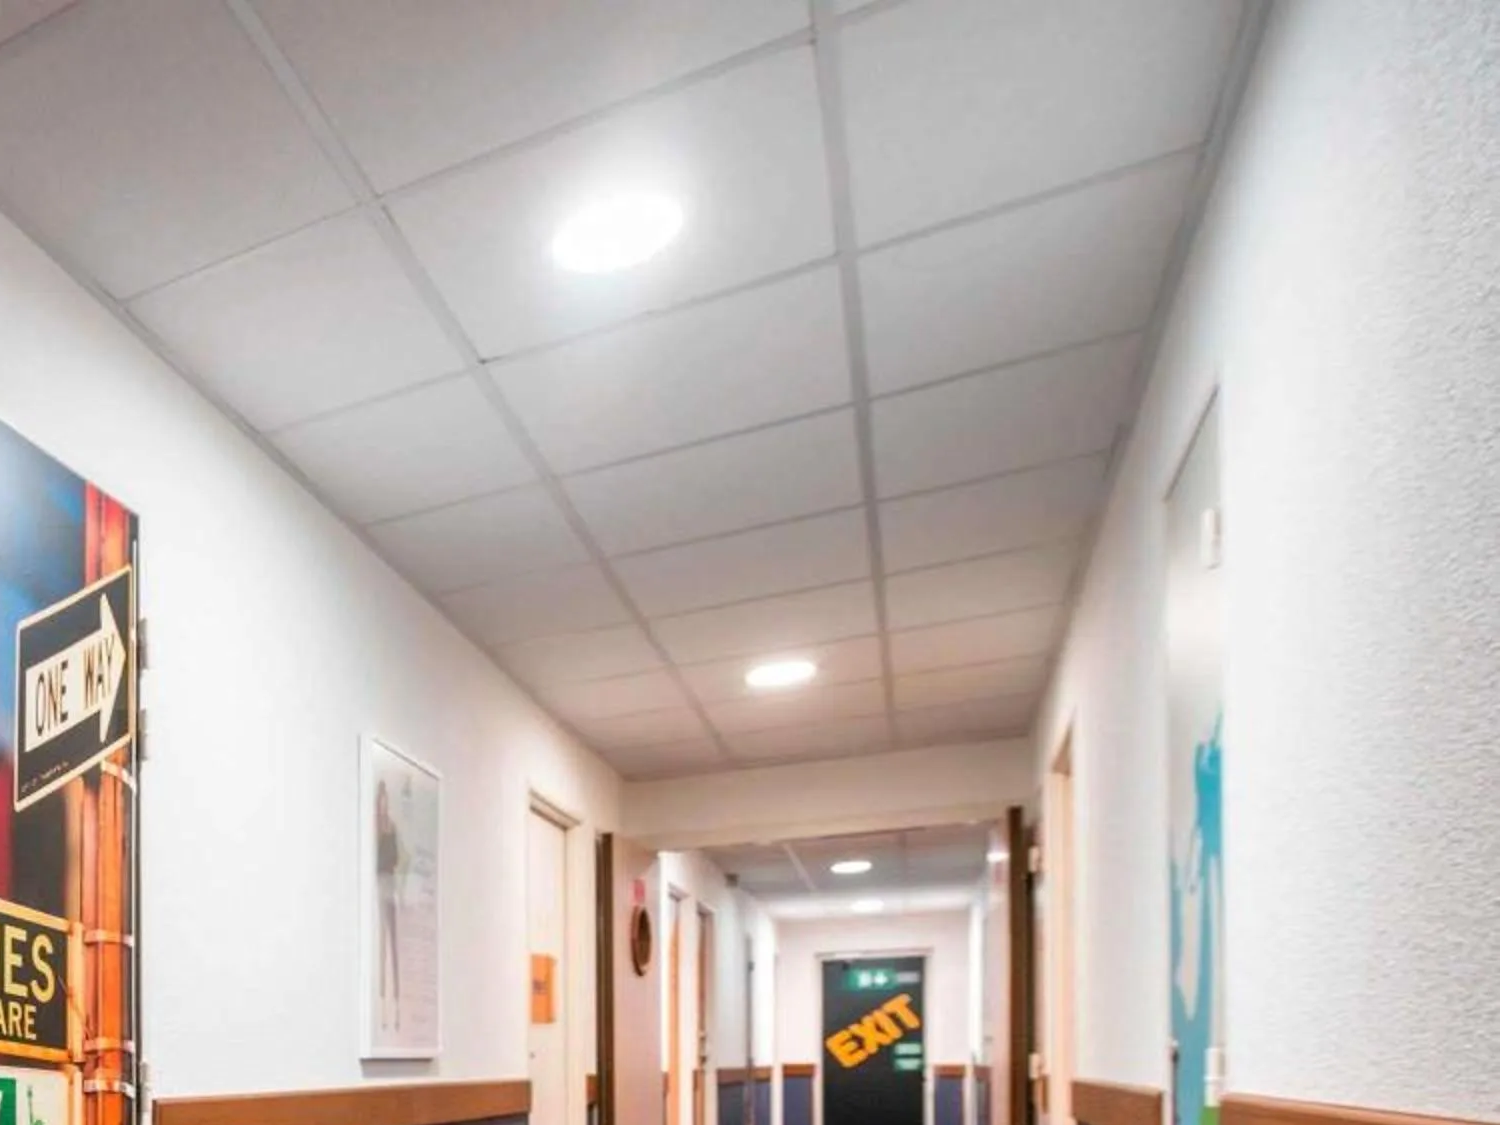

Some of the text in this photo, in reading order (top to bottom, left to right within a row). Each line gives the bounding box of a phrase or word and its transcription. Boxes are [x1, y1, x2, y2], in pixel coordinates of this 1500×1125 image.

[35, 633, 115, 737] ONE WAY
[825, 993, 921, 1068] EXIT
